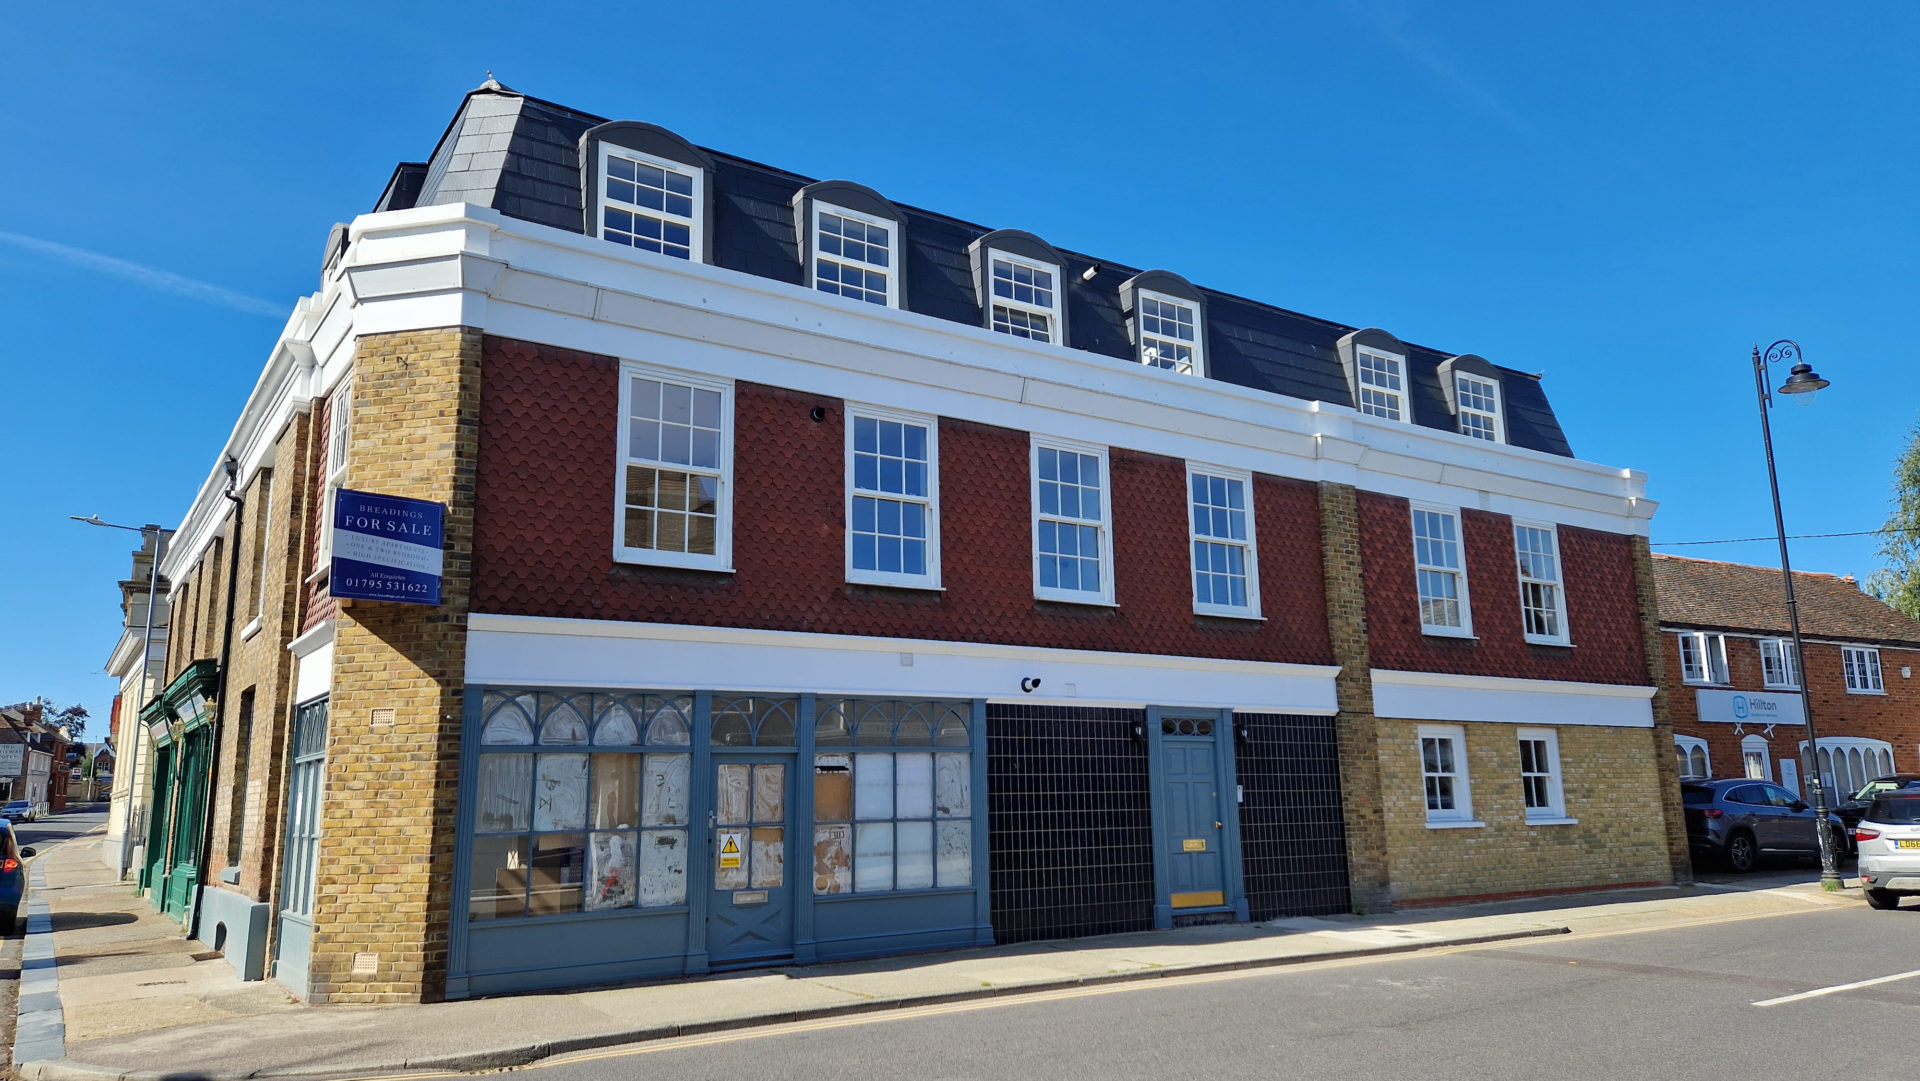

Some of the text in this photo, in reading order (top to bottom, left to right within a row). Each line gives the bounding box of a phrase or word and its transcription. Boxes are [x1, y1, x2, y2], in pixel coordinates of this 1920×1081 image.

[359, 504, 424, 520] BREADINGS
[345, 515, 432, 536] FOR SALE
[350, 541, 365, 550] ONE
[375, 546, 391, 555] TWO
[393, 549, 426, 562] BEDROOM
[352, 550, 426, 570] HIGH SPECIFICATION
[379, 572, 406, 581] Enquiries
[345, 577, 428, 593] 01795 531622
[1749, 698, 1777, 711] Hillton
